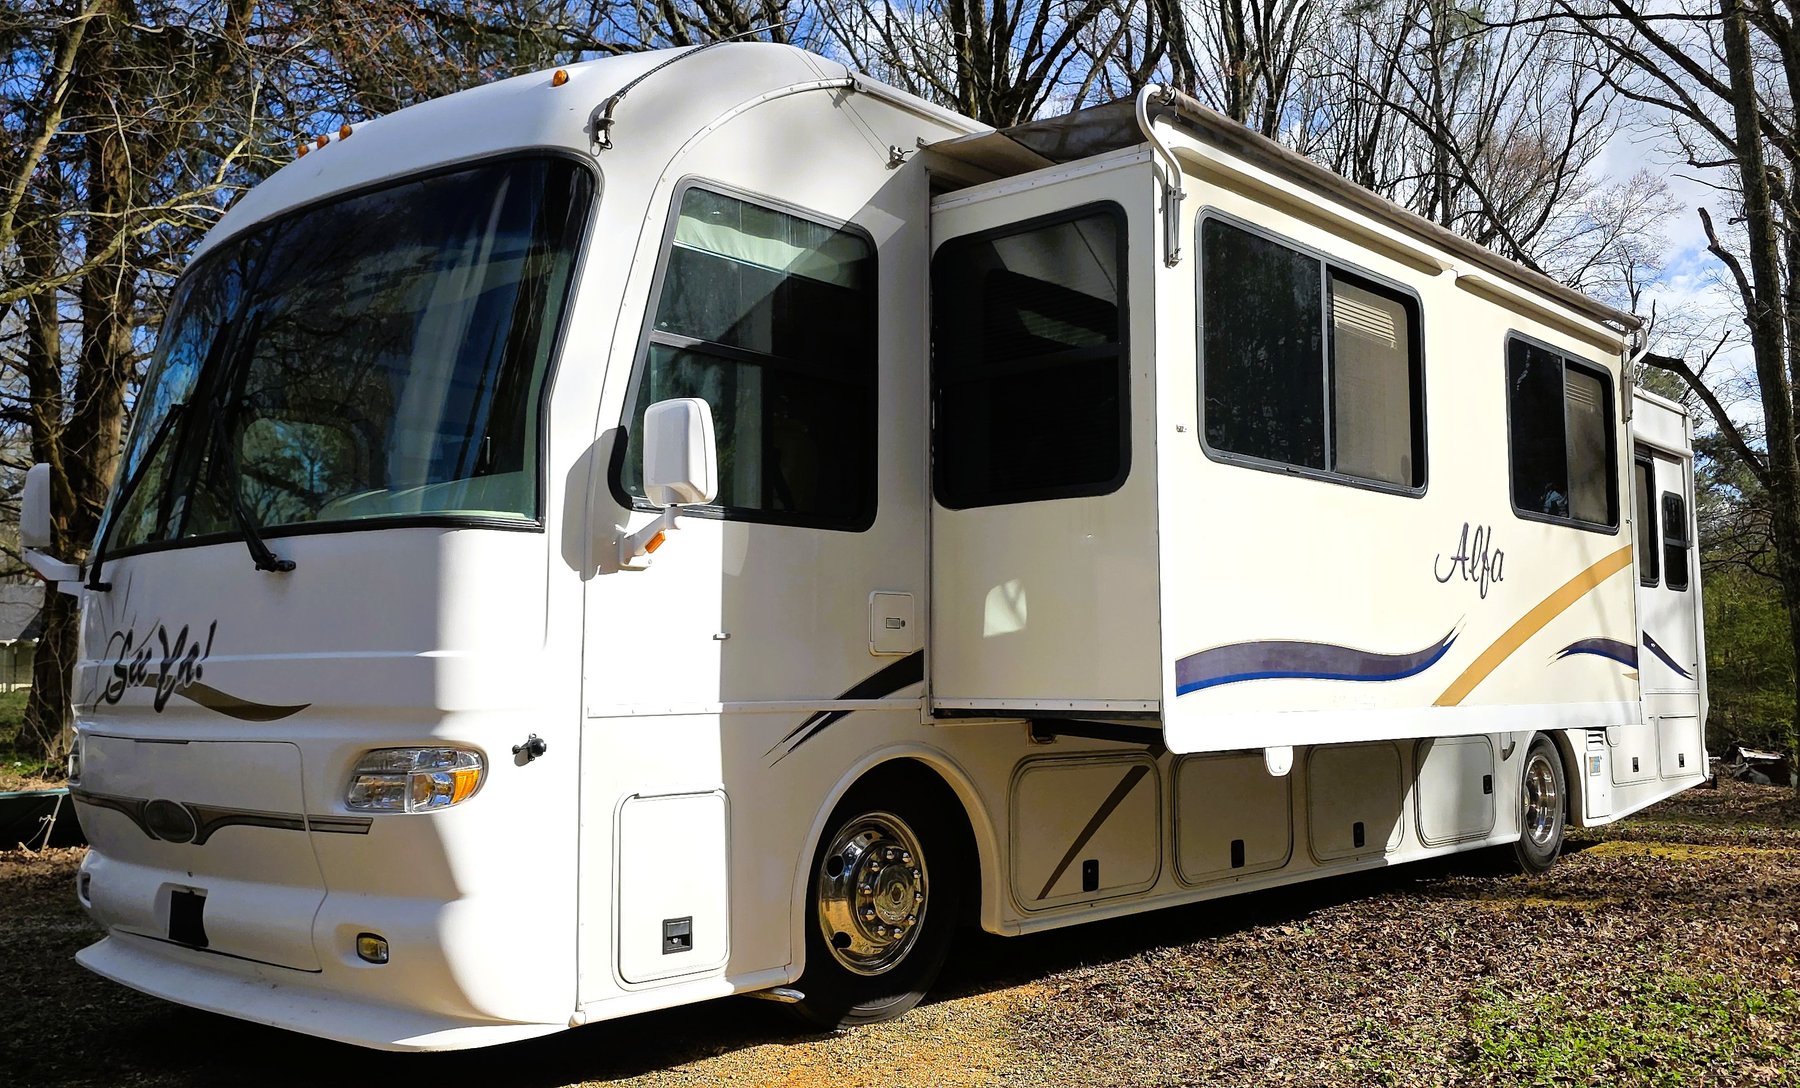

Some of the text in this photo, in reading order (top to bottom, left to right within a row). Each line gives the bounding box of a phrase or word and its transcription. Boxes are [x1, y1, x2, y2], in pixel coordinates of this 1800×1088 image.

[1434, 522, 1505, 600] Alfa
[104, 619, 218, 713] See Ya!
